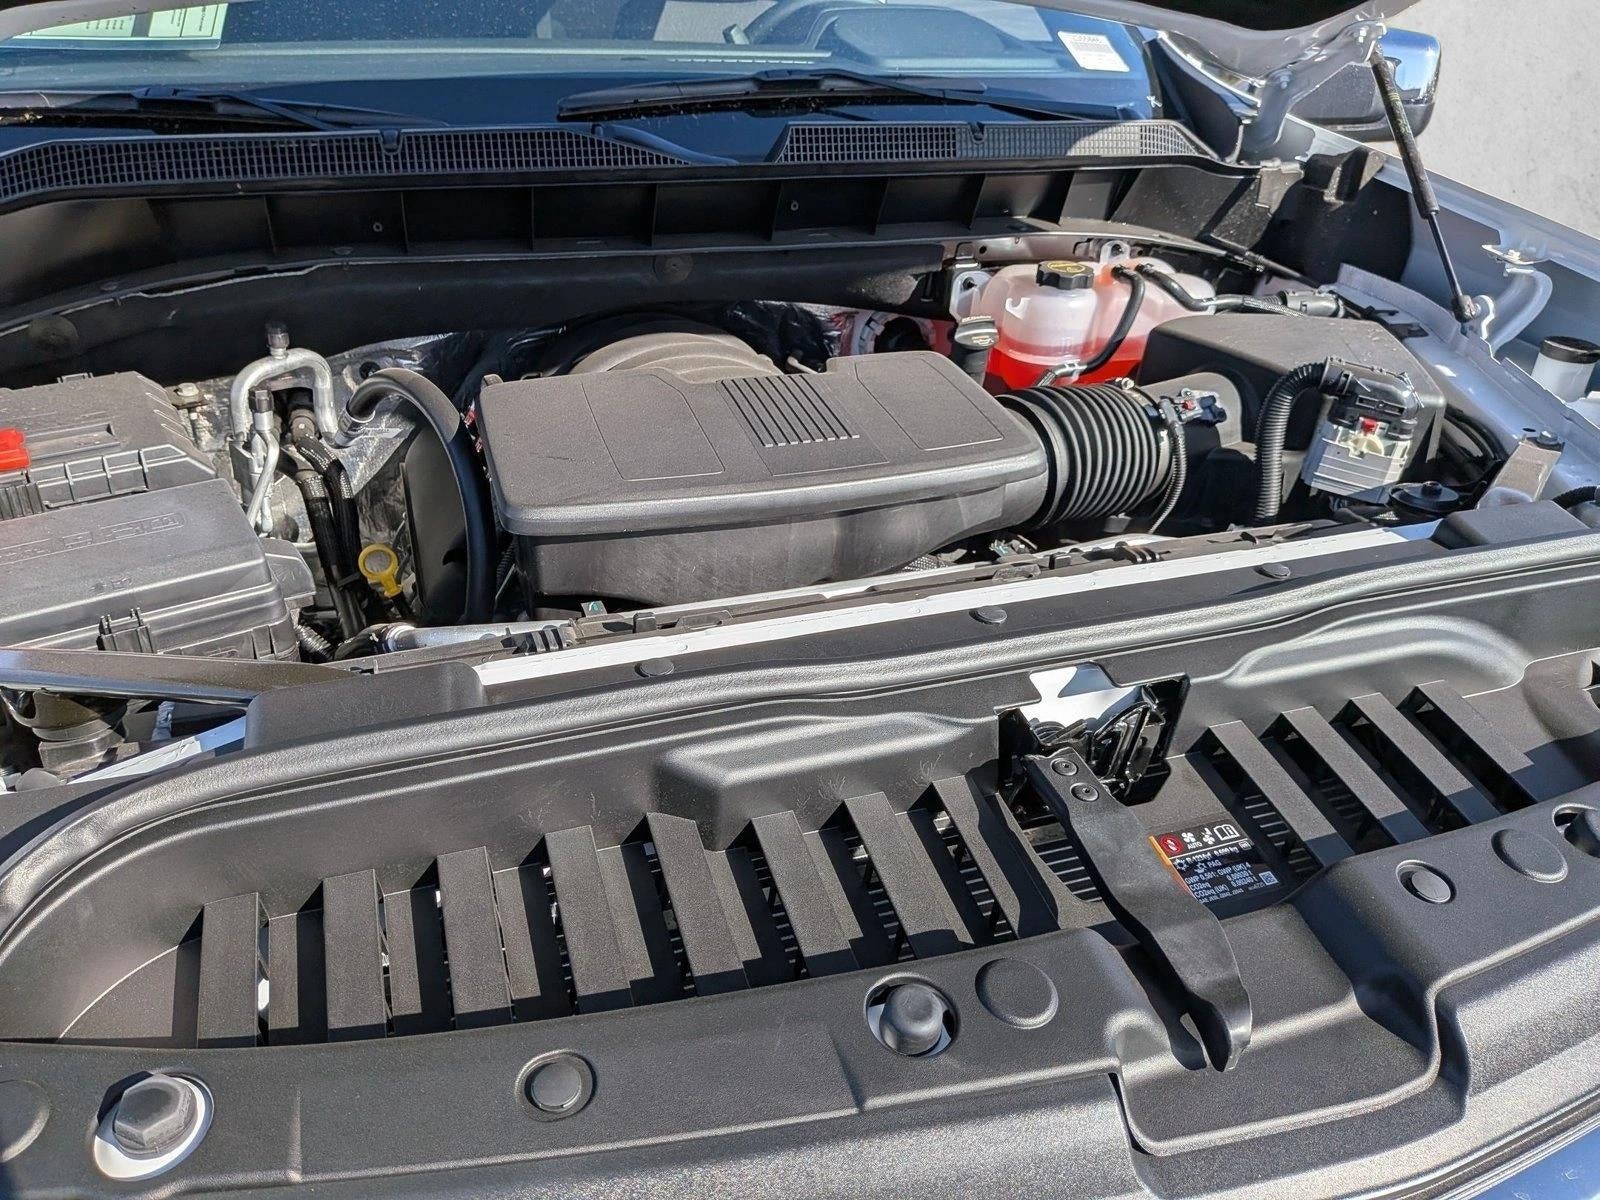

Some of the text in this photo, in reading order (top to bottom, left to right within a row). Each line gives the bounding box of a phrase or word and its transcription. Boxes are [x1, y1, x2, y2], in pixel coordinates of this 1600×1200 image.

[1187, 841, 1203, 849] AUTO
[1207, 859, 1222, 868] PAG
[1184, 875, 1200, 884] GWP
[1217, 866, 1232, 876] GWP
[1190, 882, 1212, 891] CO2eq
[1194, 889, 1217, 898] CO2eq
[1214, 884, 1230, 894] (UK)
